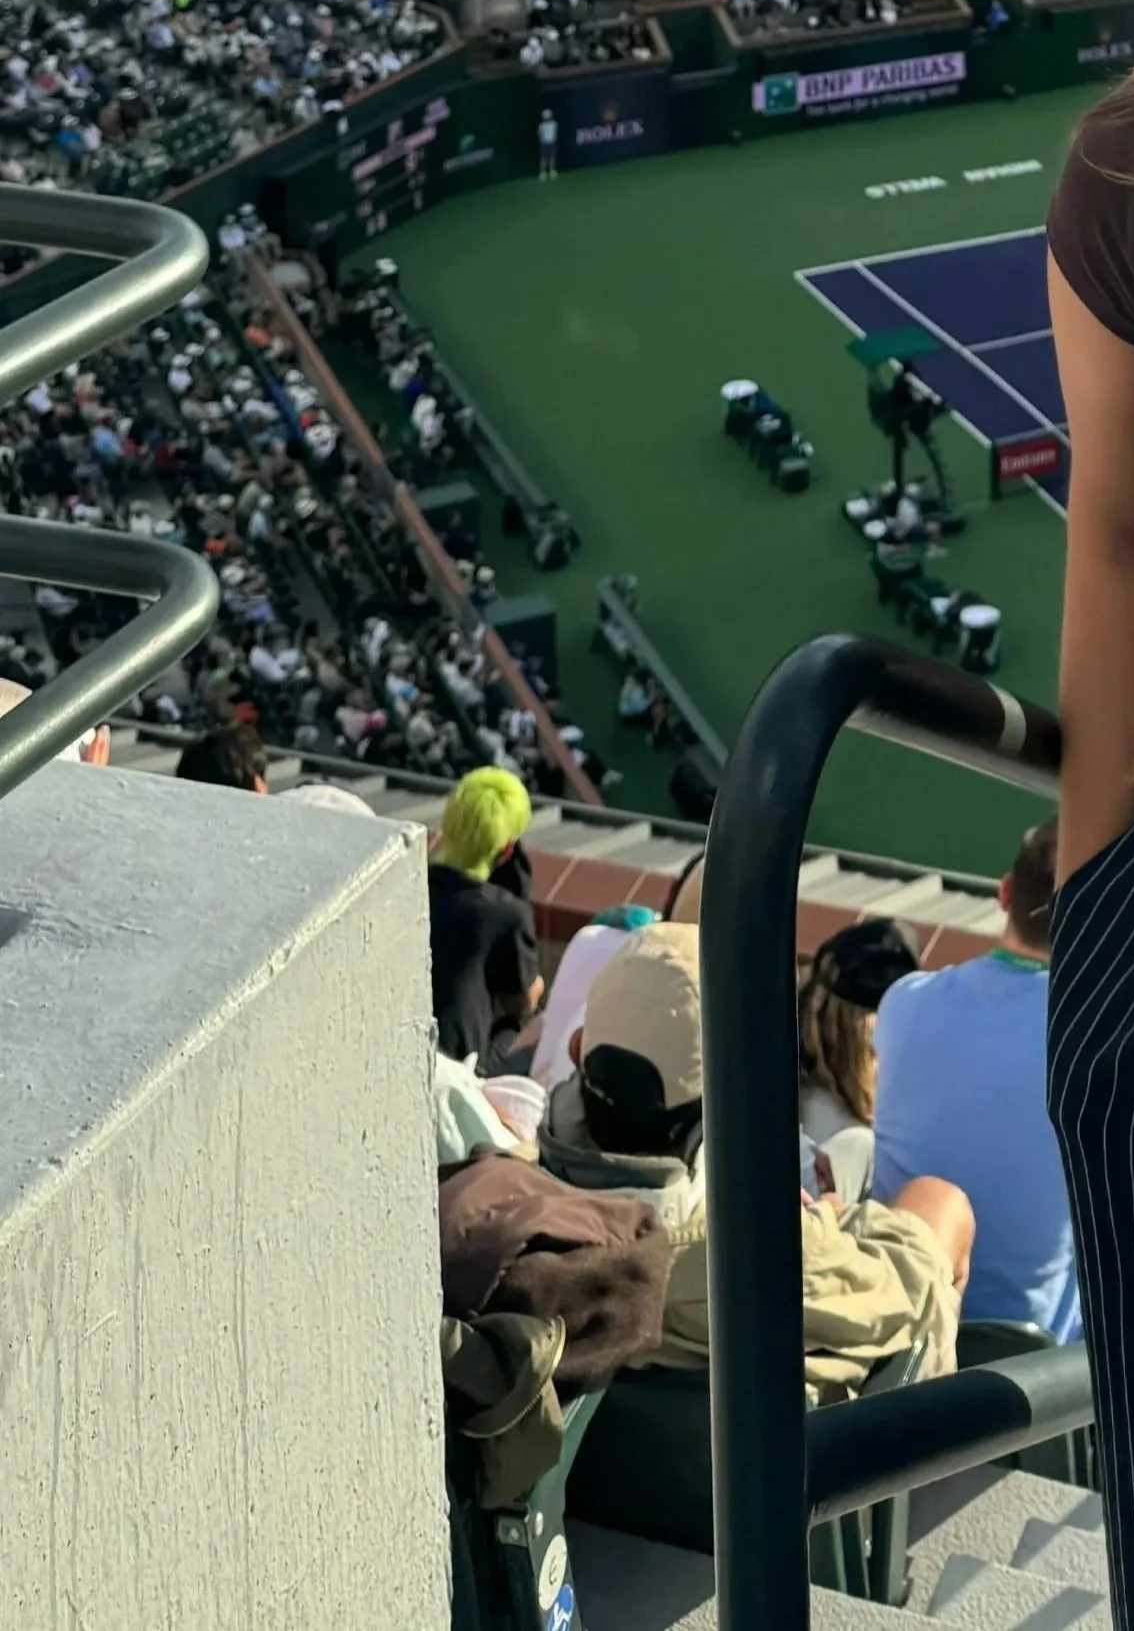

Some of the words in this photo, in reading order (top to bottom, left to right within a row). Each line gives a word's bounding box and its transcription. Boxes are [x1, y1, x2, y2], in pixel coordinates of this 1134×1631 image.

[805, 74, 853, 99] BNP
[861, 56, 959, 90] PARIBAS
[576, 120, 645, 146] ROLEX
